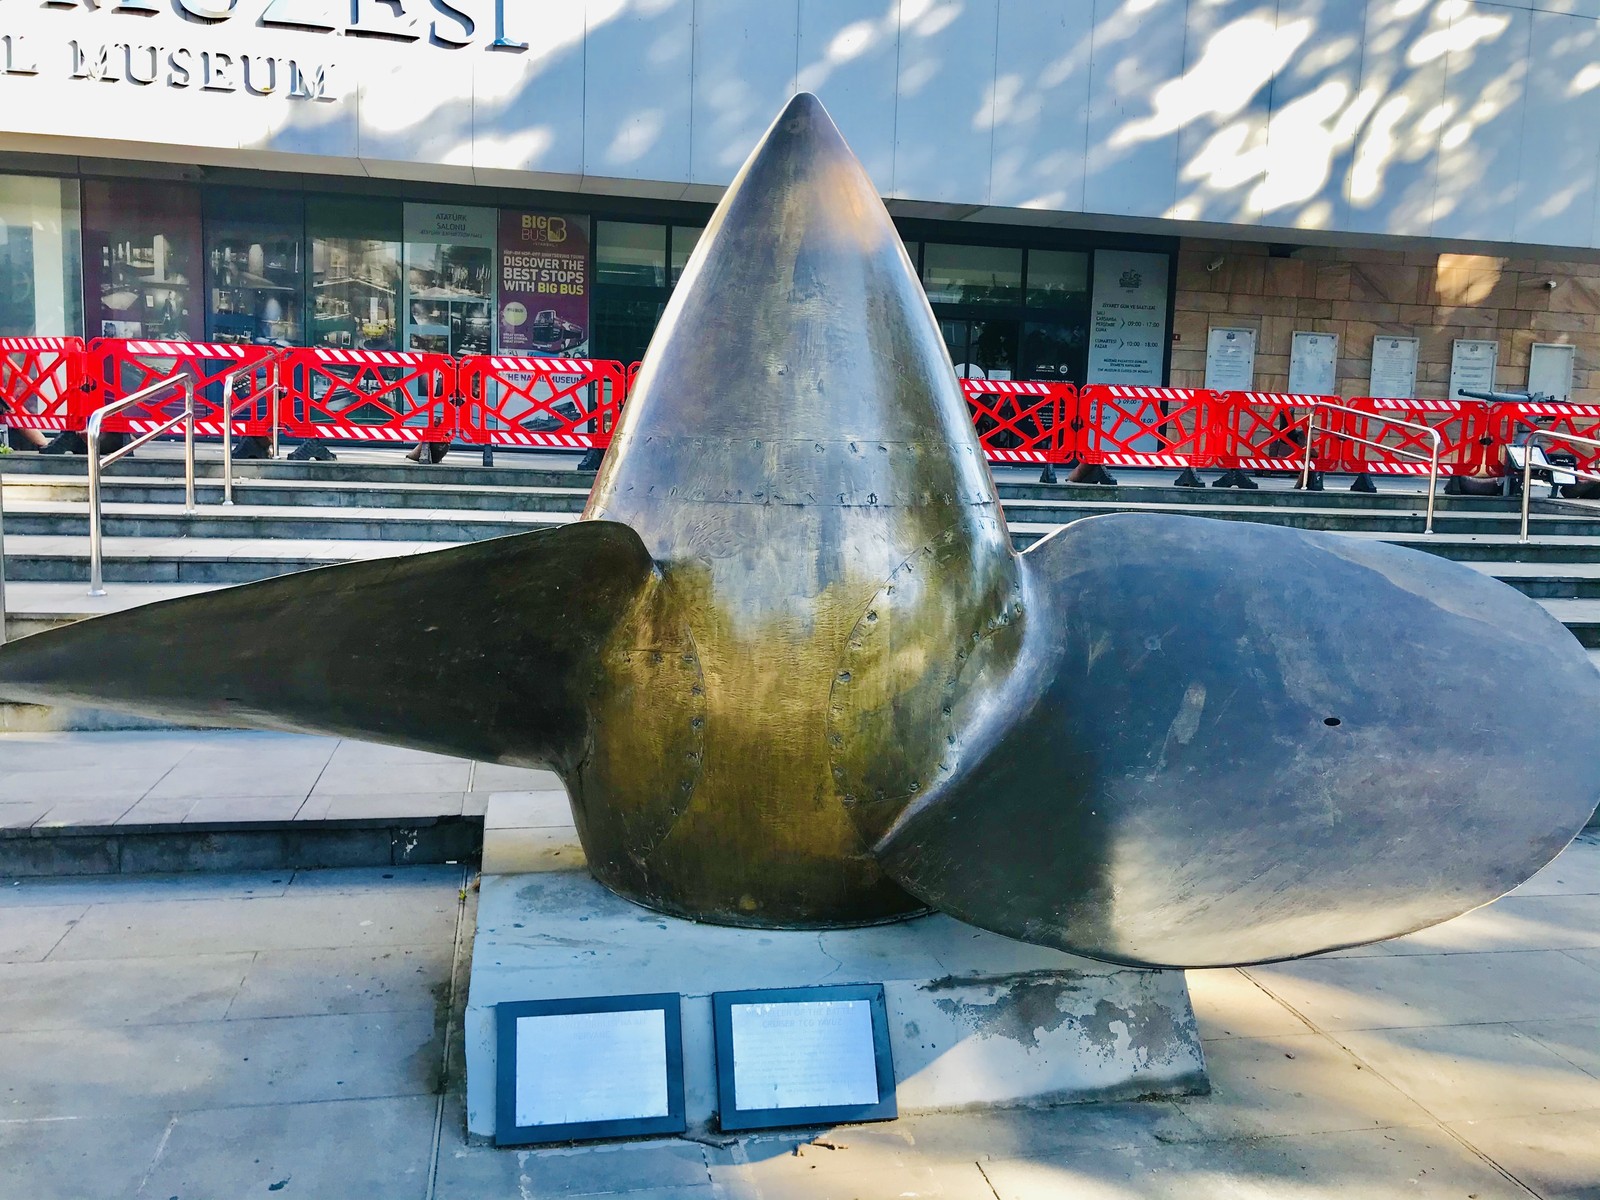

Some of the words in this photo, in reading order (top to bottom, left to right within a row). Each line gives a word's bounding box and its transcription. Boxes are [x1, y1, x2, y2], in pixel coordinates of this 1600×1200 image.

[68, 39, 337, 103] MUSEUM
[436, 222, 466, 231] SALONU
[521, 214, 547, 229] BIG
[521, 228, 547, 241] BUS
[503, 255, 560, 269] DISCOVER
[561, 259, 585, 271] THE
[503, 267, 539, 281] BEST
[540, 269, 584, 284] STOPS
[503, 280, 535, 292] WITH
[537, 282, 558, 294] BIG
[560, 283, 584, 295] BUS
[520, 374, 547, 382] NAAL
